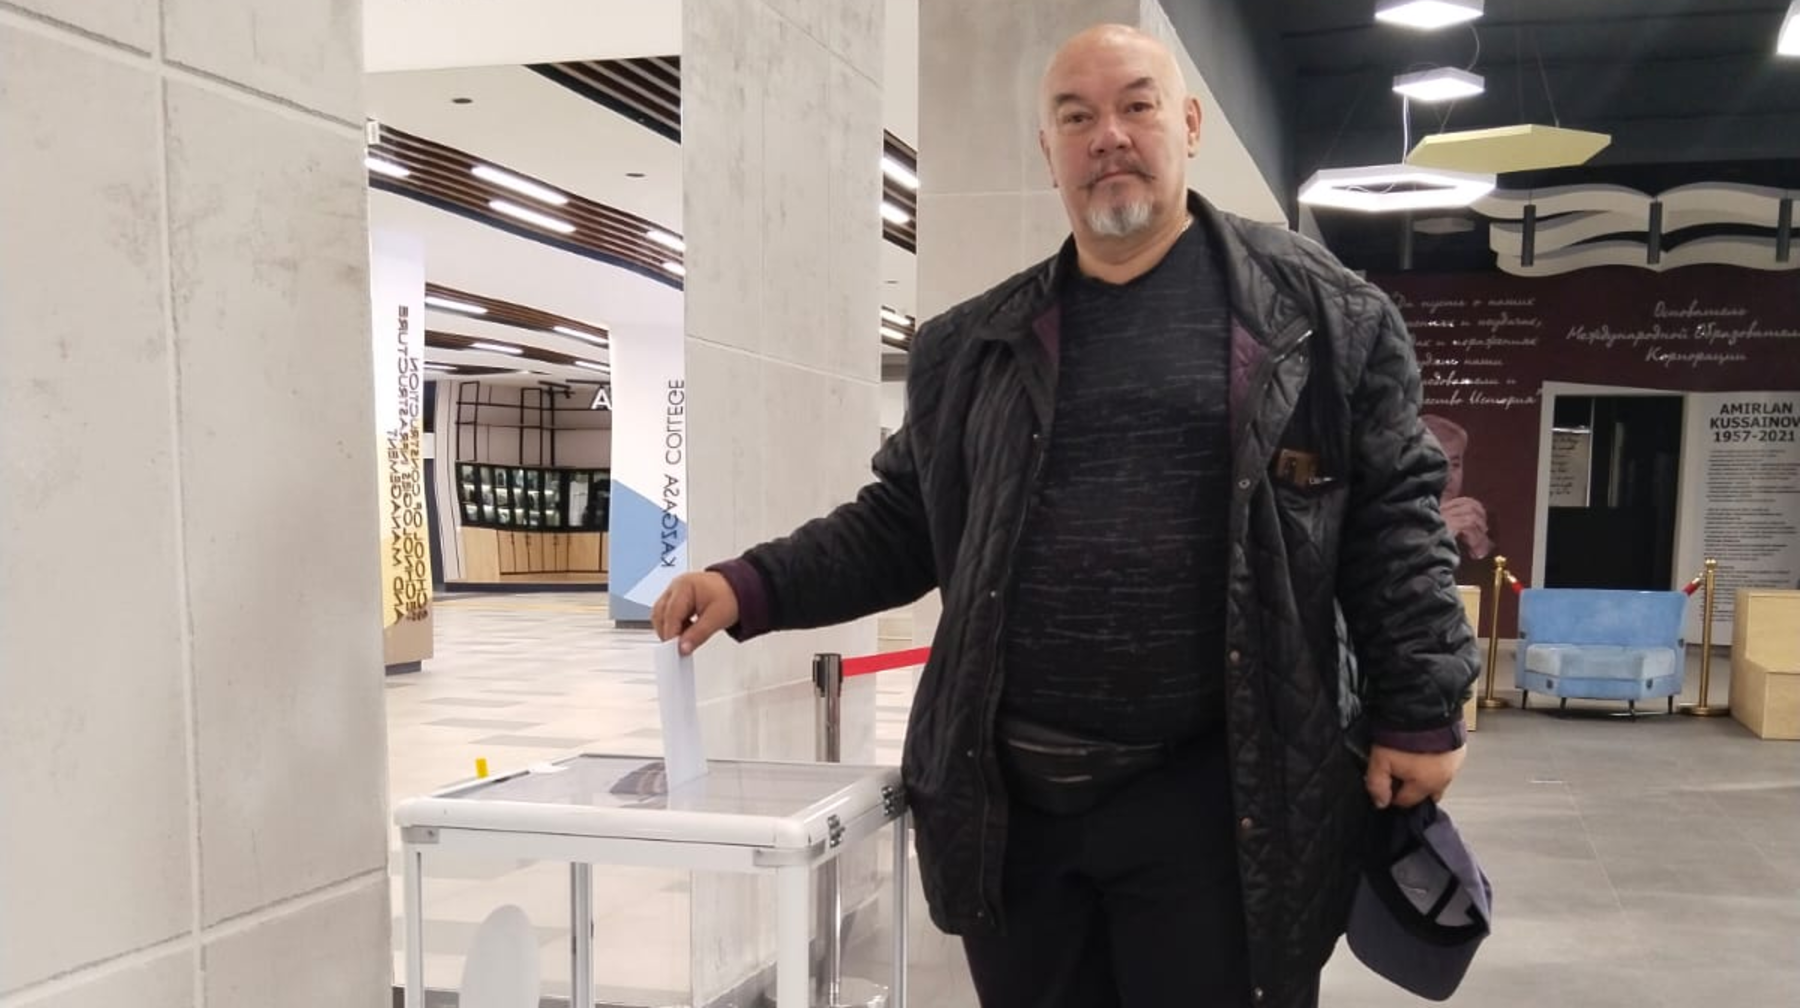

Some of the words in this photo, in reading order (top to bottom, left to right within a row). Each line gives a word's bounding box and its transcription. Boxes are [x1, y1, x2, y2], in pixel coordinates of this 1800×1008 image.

[1566, 323, 1690, 348] Международной
[1645, 346, 1747, 368] Корпорации
[1720, 402, 1793, 416] AMIRLAN
[1709, 416, 1800, 429] KUSSAINOV
[1714, 430, 1795, 443] 1957-2021
